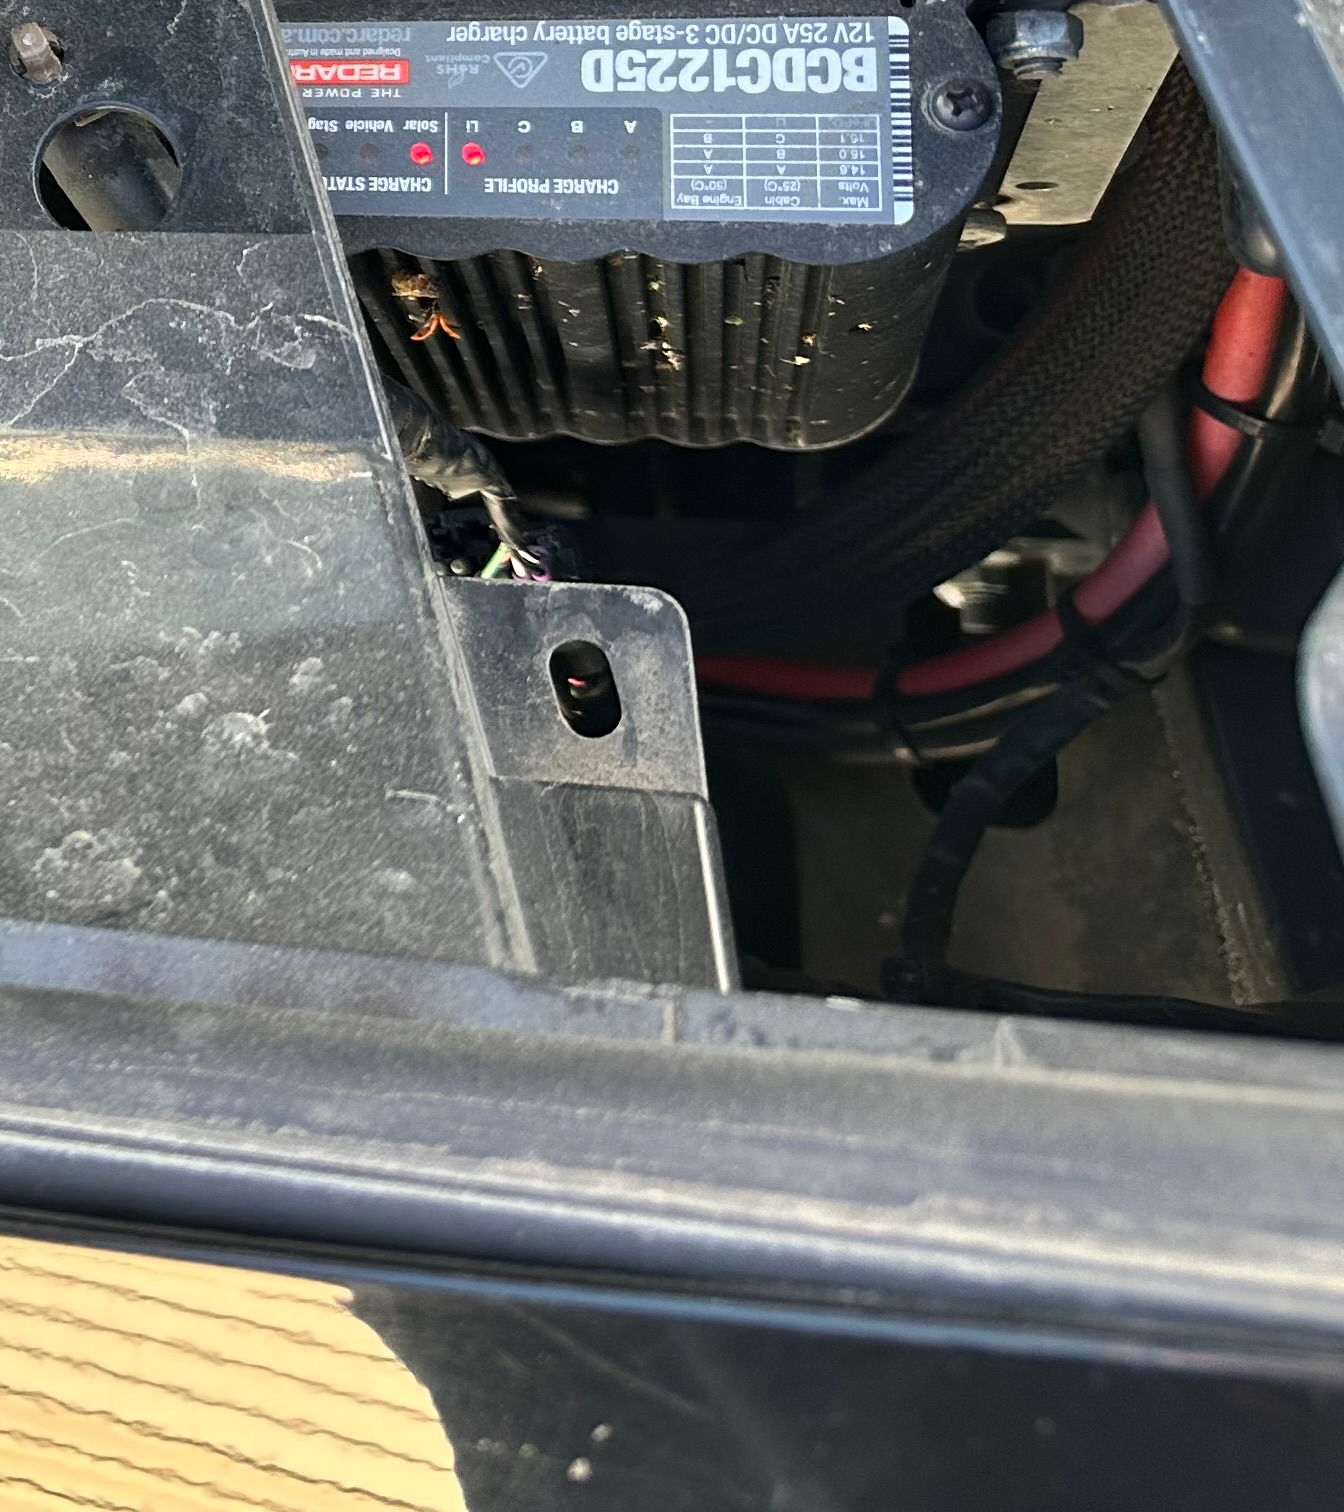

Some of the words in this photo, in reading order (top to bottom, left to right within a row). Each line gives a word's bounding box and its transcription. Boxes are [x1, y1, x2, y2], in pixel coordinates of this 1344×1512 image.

[446, 21, 528, 46] charger
[532, 21, 610, 46] battery
[615, 20, 700, 45] 3-stage
[705, 23, 777, 45] DC/DC
[782, 22, 828, 44] 25A
[833, 22, 875, 44] 12V
[320, 48, 343, 57] made
[344, 48, 361, 57] and
[424, 52, 491, 64] Compliant
[436, 63, 480, 75] RoHS
[580, 47, 878, 94] BCDC1225D
[302, 87, 362, 98] POWER
[370, 88, 401, 98] THE
[344, 119, 393, 133] Vehicle
[402, 119, 438, 133] Solar
[465, 119, 479, 134] Li
[517, 120, 531, 134] C
[570, 120, 584, 134] B
[624, 120, 637, 134] A
[703, 133, 713, 144] B
[703, 148, 713, 160] A
[776, 148, 786, 159] B
[703, 164, 713, 175] A
[776, 164, 786, 175] A
[839, 164, 865, 176] 14.6
[368, 176, 432, 192] CHARGE
[484, 177, 550, 193] PROFILE
[553, 178, 619, 195] CHARGE
[838, 181, 869, 192] Volts
[677, 192, 700, 205] Bay
[702, 193, 742, 206] Engine
[764, 195, 801, 207] Cabin
[839, 196, 869, 208] Max.
